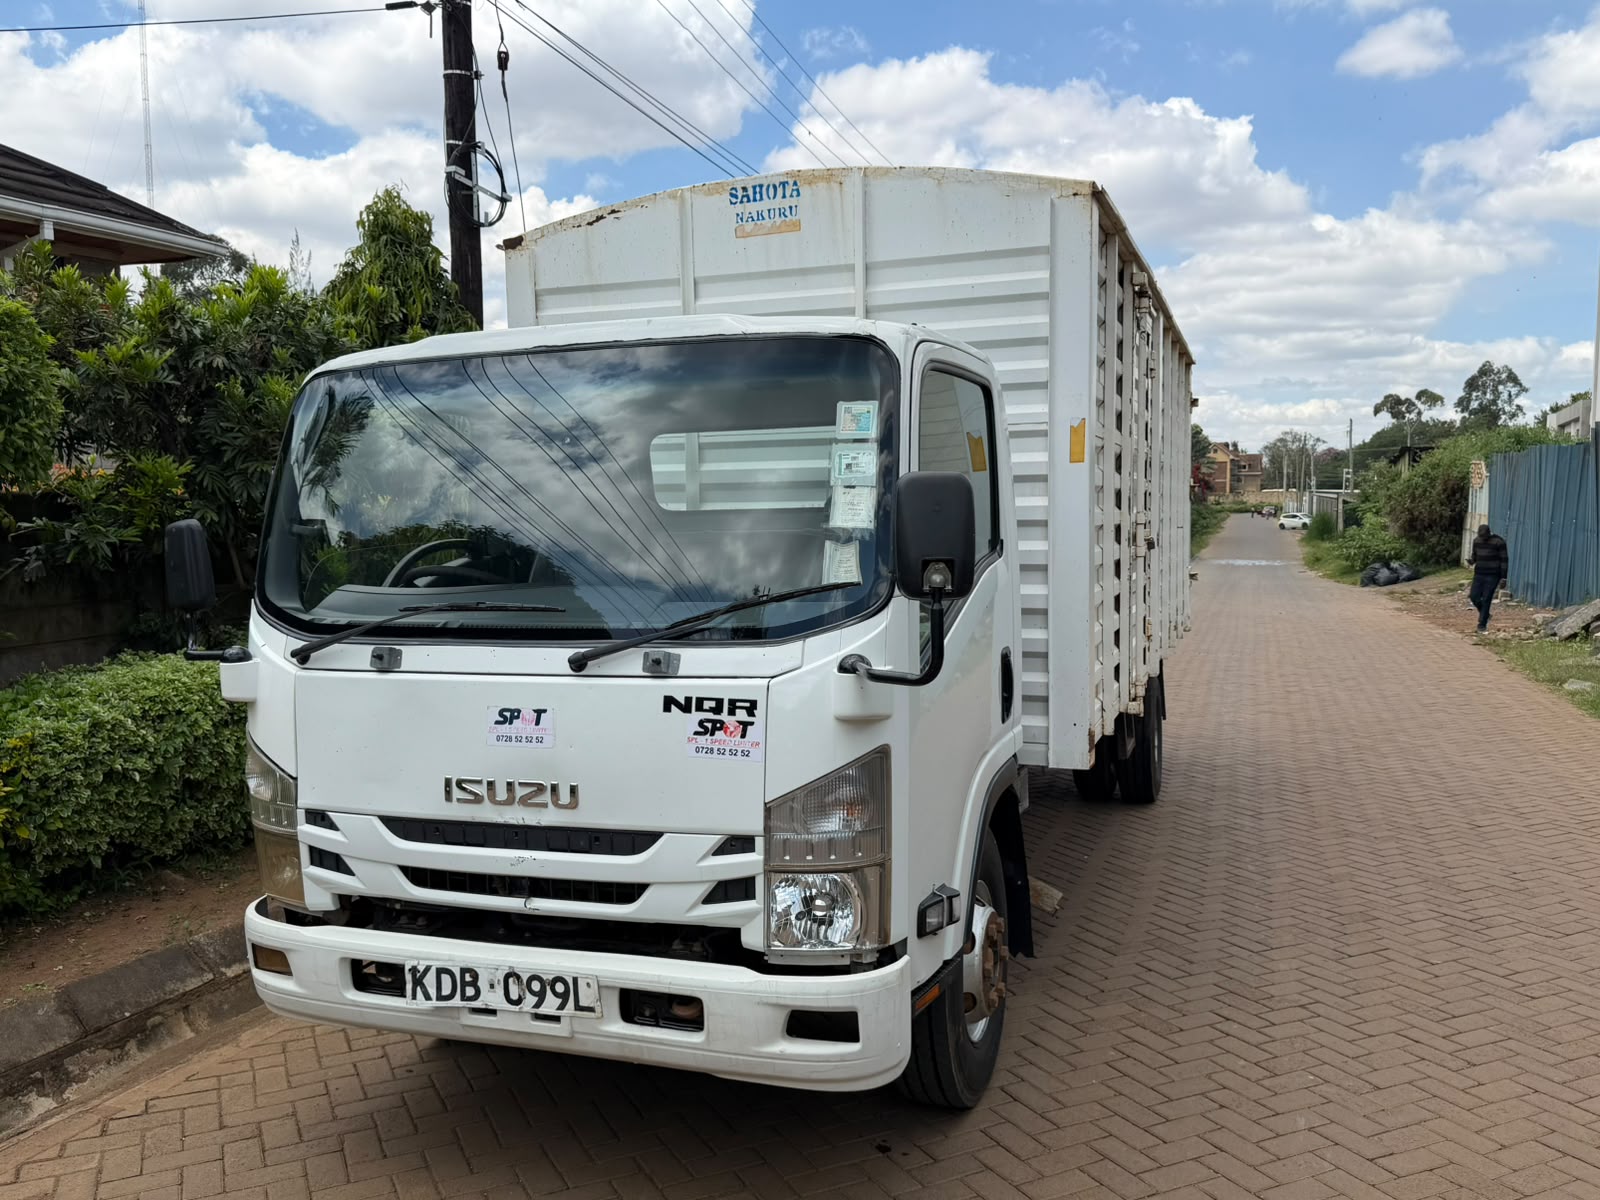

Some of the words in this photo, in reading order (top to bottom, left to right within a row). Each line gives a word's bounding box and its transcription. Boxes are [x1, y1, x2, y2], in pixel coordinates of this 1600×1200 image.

[729, 180, 801, 206] SAHOTA
[735, 204, 799, 224] NAKURU
[662, 694, 758, 718] NQR
[496, 734, 513, 743] 0728
[514, 735, 523, 743] 52
[525, 735, 534, 744] 52
[535, 735, 544, 744] 52
[695, 746, 715, 755] 0728
[716, 747, 727, 756] 52
[728, 748, 739, 757] 52
[740, 749, 751, 758] 52
[444, 775, 579, 810] ISUZU
[410, 965, 482, 1002] KDB
[502, 971, 596, 1013] 099L
